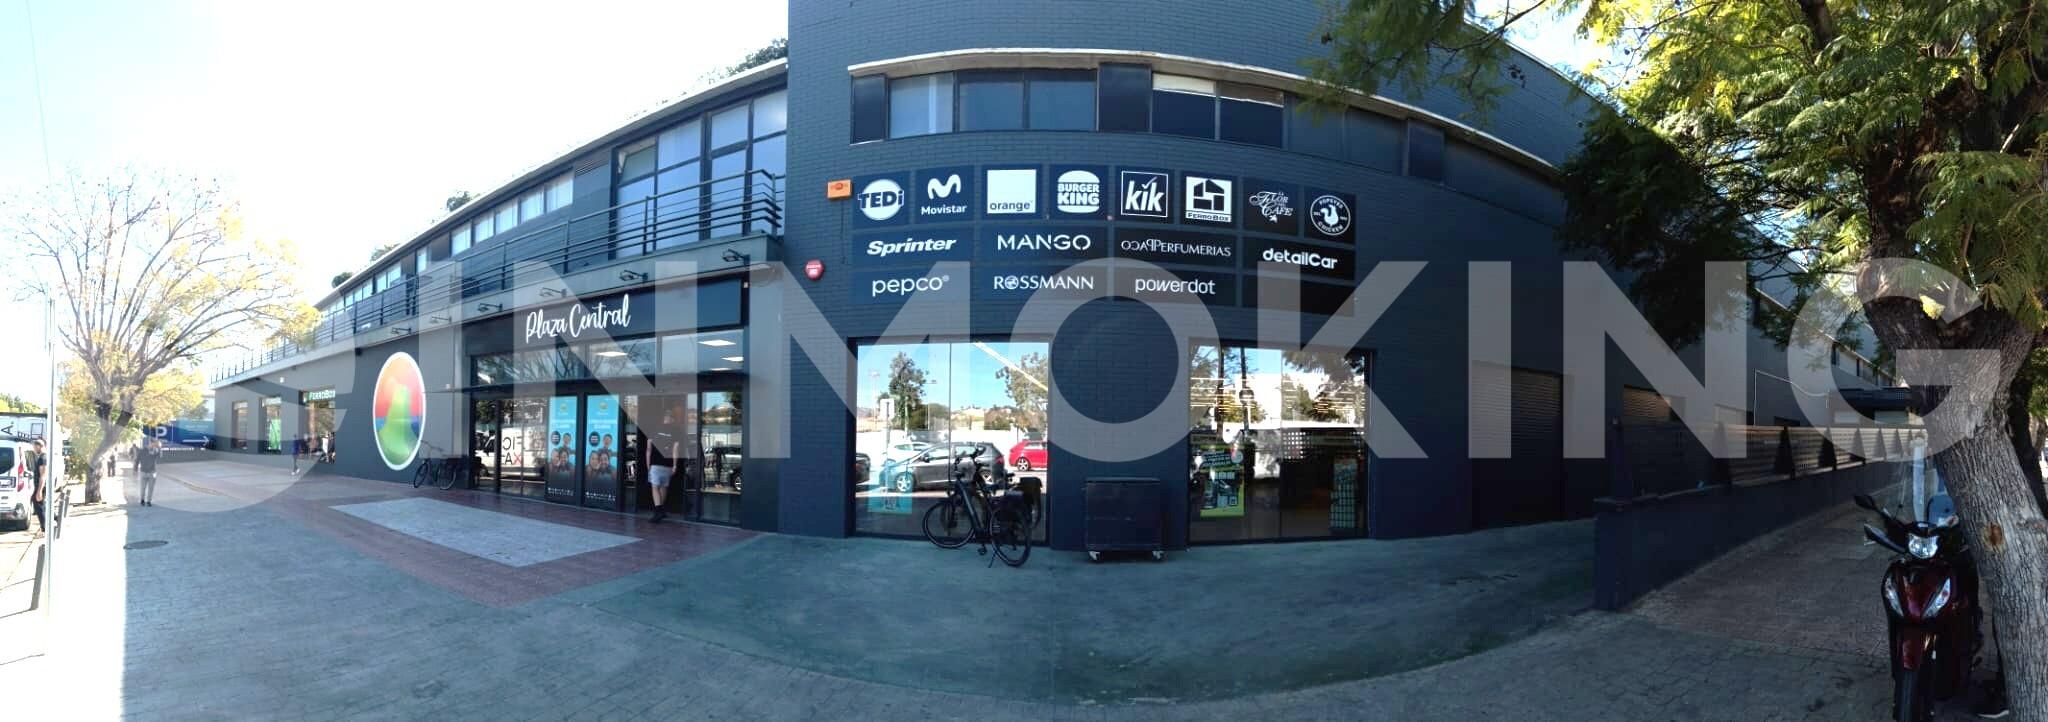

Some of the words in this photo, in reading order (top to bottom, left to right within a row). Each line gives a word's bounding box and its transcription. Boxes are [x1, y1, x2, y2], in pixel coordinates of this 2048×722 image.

[1057, 183, 1100, 193] BURGER
[1125, 176, 1166, 213] kik
[858, 189, 904, 209] TEDi
[989, 201, 1031, 212] orange
[1057, 193, 1100, 206] KING
[921, 204, 967, 216] Movistar
[867, 237, 957, 257] Sprinter
[997, 234, 1091, 251] MANGO
[1262, 248, 1338, 270] detailCar
[994, 275, 1094, 290] ROSSMANN
[1135, 277, 1216, 295] powerdot
[525, 309, 568, 344] Plaza
[568, 293, 631, 338] Central
